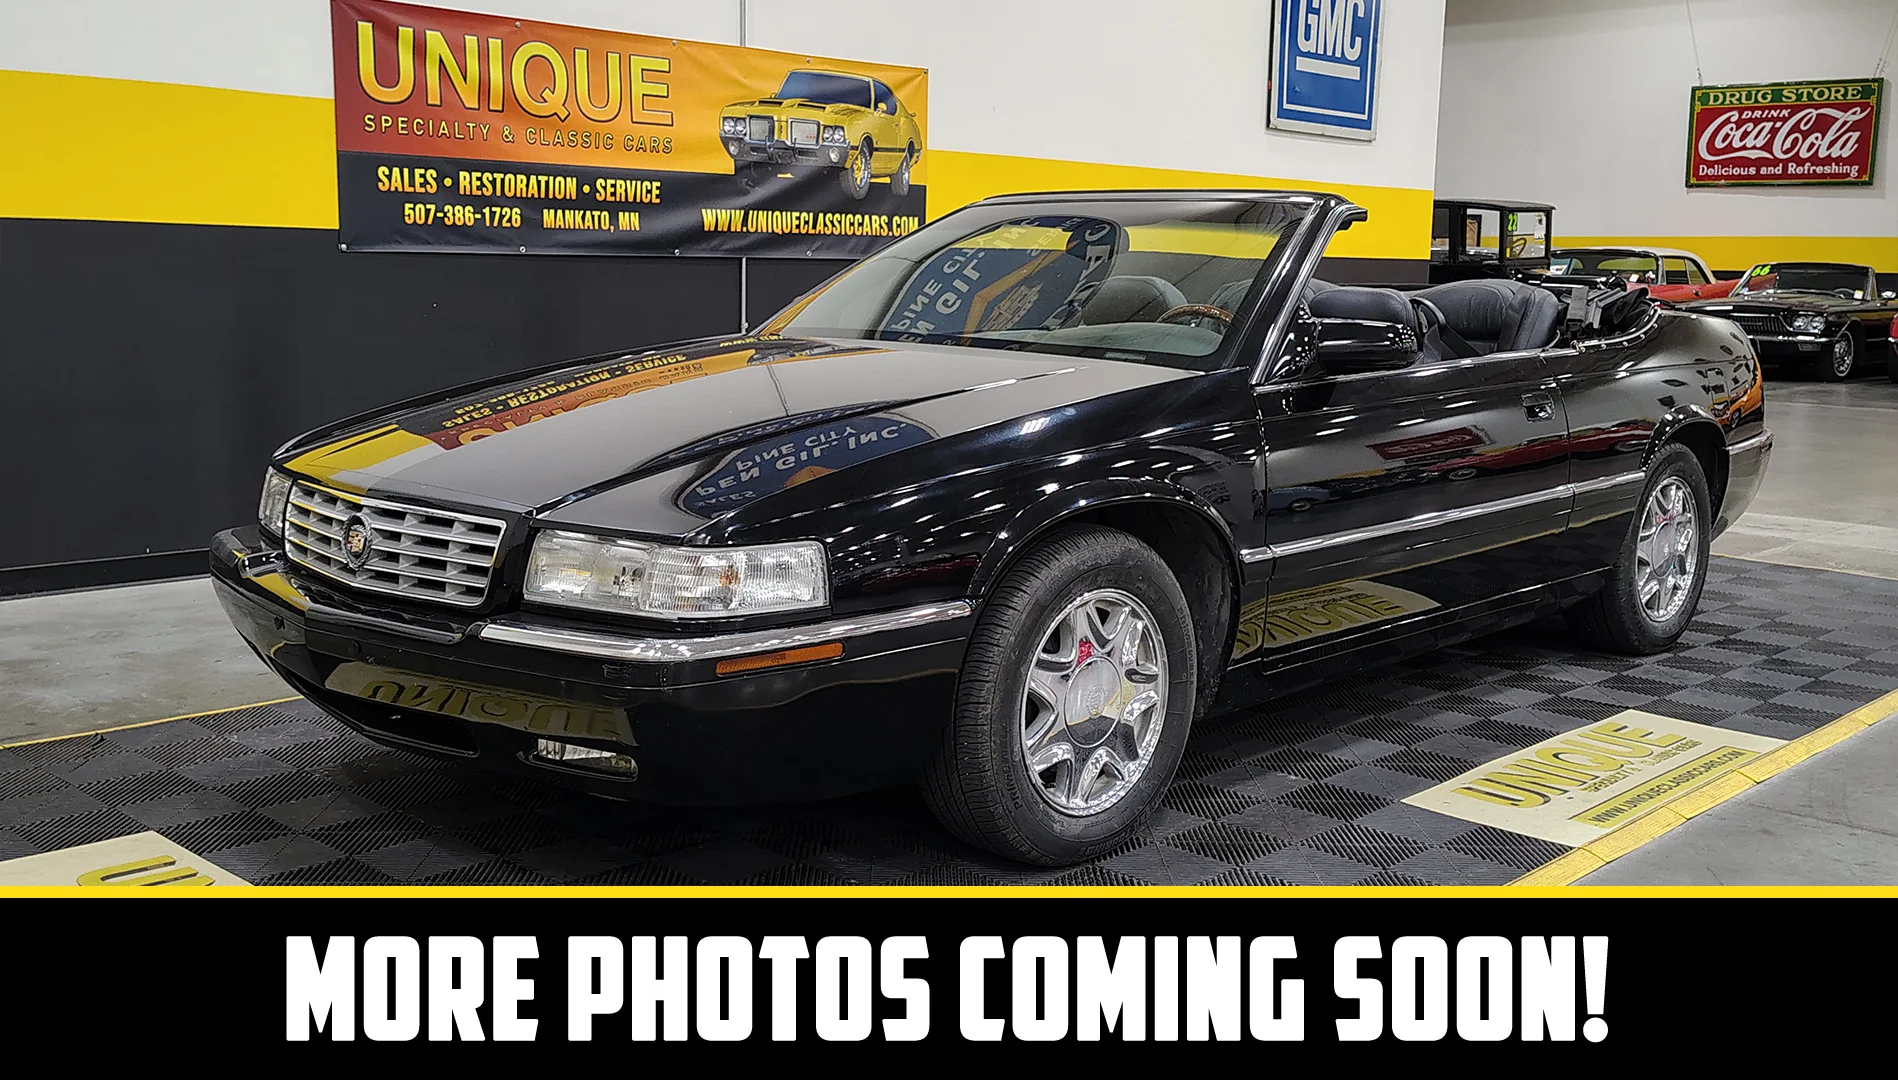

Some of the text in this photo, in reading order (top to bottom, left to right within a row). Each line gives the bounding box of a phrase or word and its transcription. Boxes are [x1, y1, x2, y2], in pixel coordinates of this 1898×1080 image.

[1297, 0, 1365, 61] GMC
[356, 20, 674, 126] UNIQUE
[1708, 86, 1862, 105] DRUG STORE
[1741, 108, 1792, 119] DRINK
[364, 113, 673, 154] SPECIALTY & CLASSIC CARS
[1698, 106, 1871, 161] Coca-Cola
[1699, 162, 1859, 177] Delicious and Refreshing
[377, 166, 661, 204] SALES RESTORATION SERVICE
[404, 203, 640, 233] 507-386-1726 MANKATO, MN
[701, 208, 919, 237] WWW.UNIQUECLASSICCARS.COM
[1508, 213, 1518, 231] 22
[1751, 265, 1771, 277] 66
[1450, 721, 1689, 809] UNIQUE
